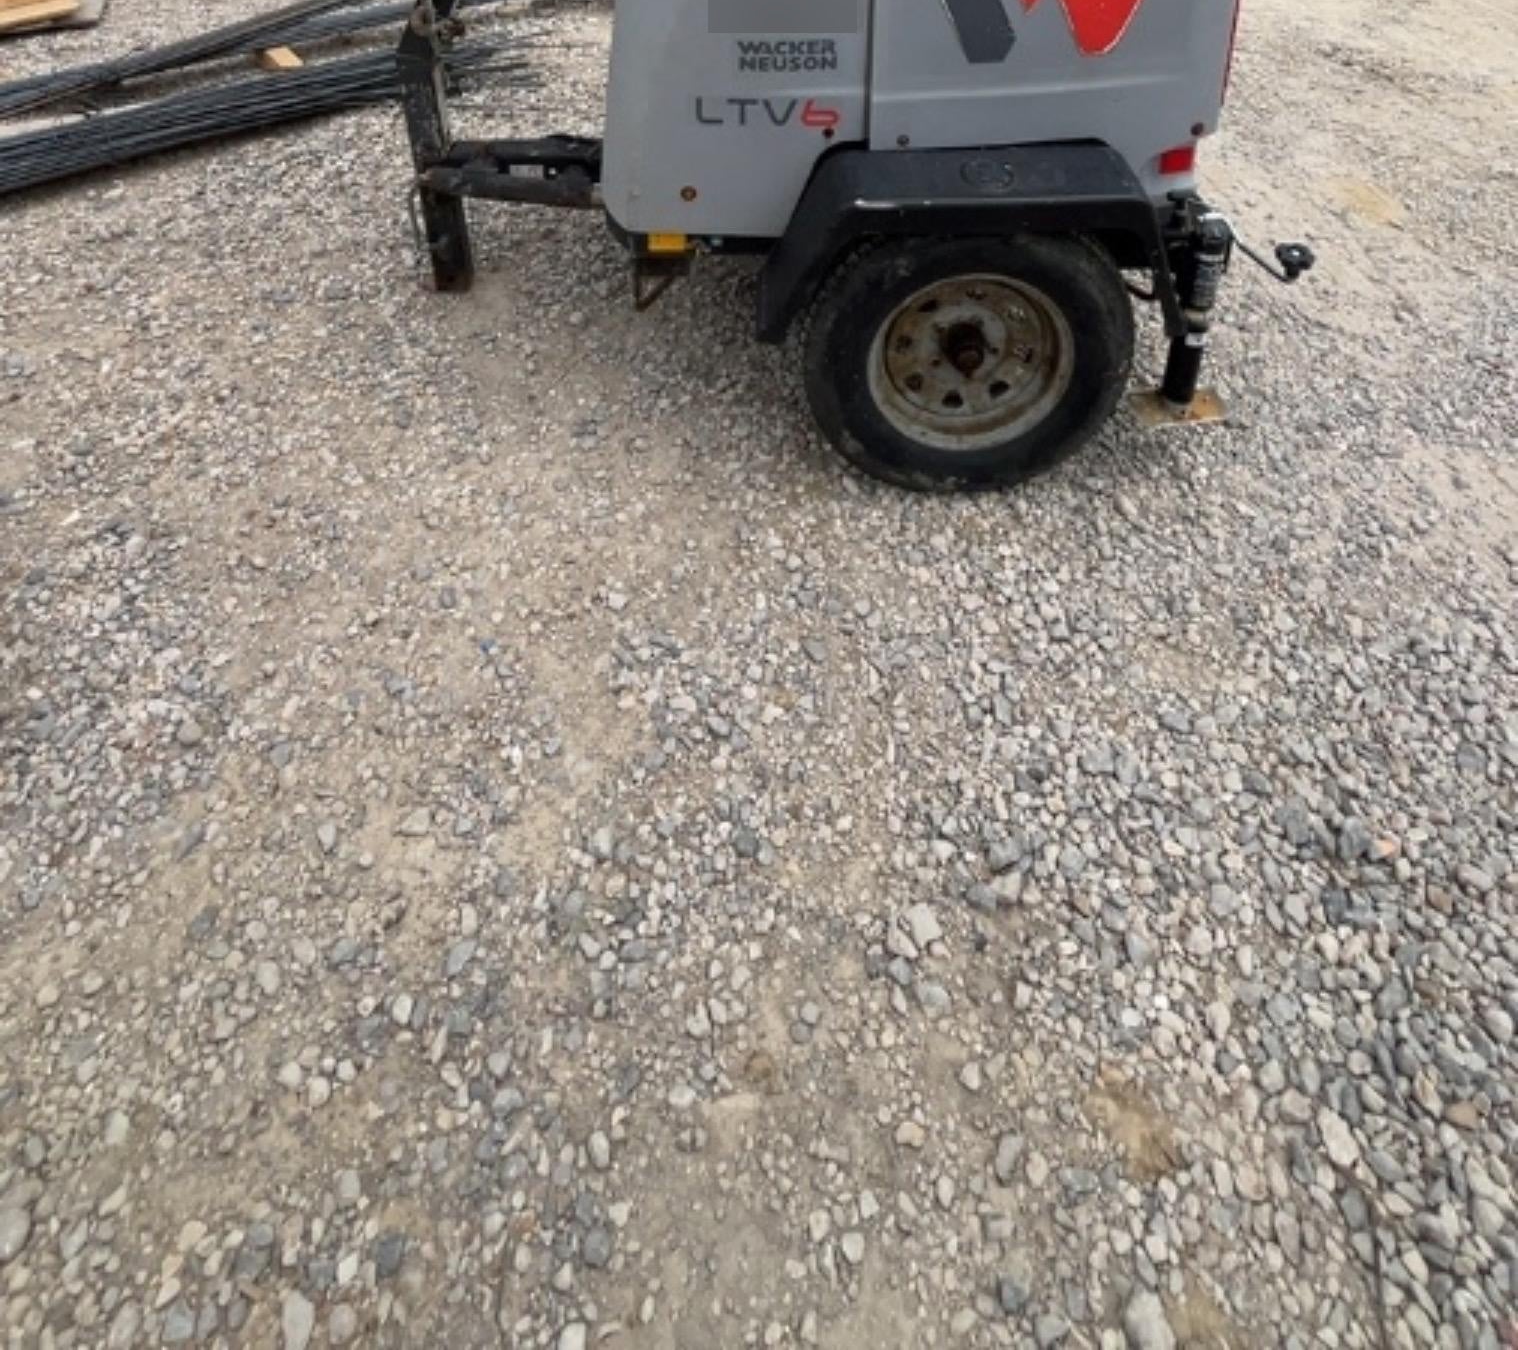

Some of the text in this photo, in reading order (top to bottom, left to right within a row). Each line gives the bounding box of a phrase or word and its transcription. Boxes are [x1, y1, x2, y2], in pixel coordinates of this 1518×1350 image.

[737, 39, 836, 55] WACKER
[738, 56, 838, 72] NEUSON
[696, 97, 839, 127] LTV6
